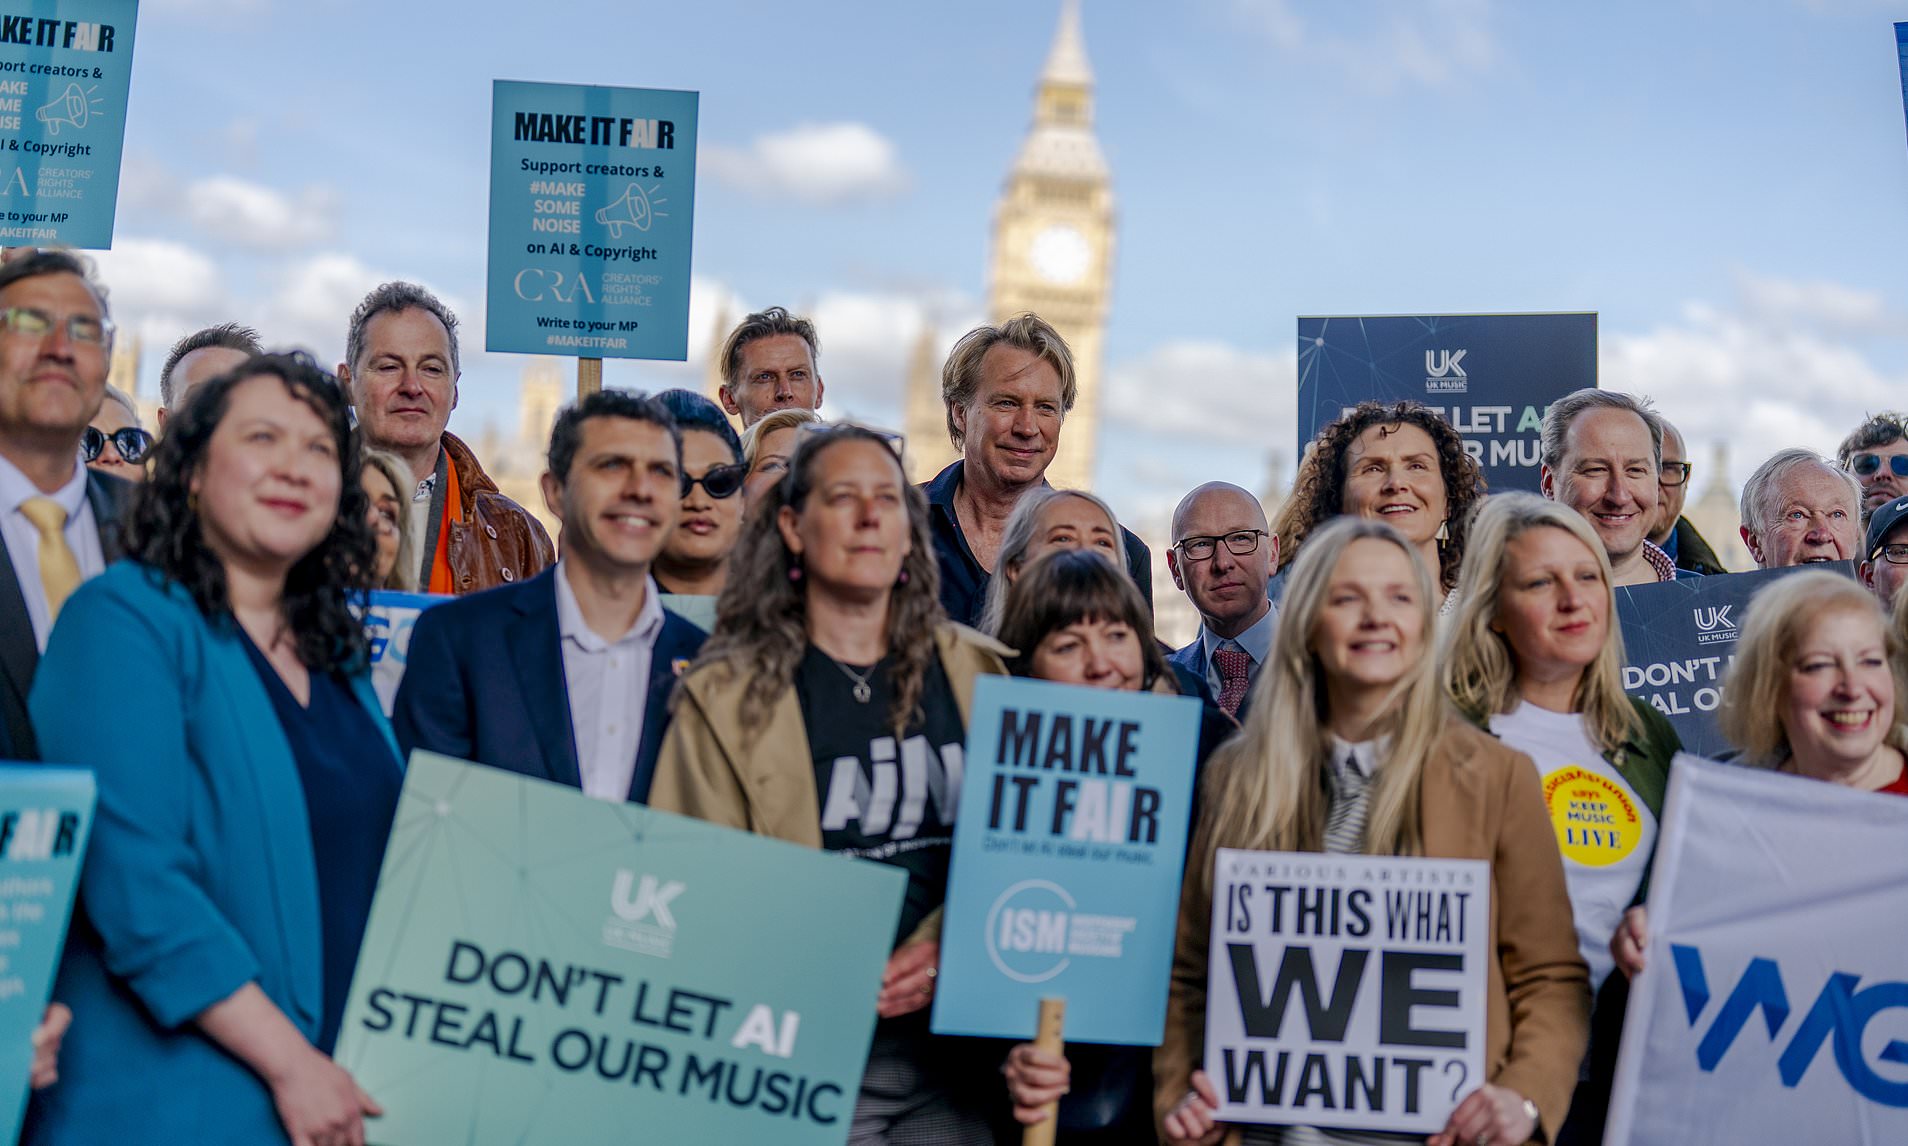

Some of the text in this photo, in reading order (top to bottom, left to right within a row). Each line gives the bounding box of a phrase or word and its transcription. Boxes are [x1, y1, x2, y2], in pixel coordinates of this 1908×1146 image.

[0, 14, 116, 52] KE IT FAIR
[30, 63, 89, 79] creators
[92, 67, 102, 79] &
[514, 111, 675, 149] MAKE IT FAIR
[9, 140, 19, 151] &
[23, 140, 91, 157] Copyright
[521, 158, 665, 178] Support creators &
[36, 188, 83, 199] ALLIANCE
[37, 178, 73, 188] RIGHTS
[530, 180, 586, 197] #MAKE
[8, 212, 19, 221] to
[22, 213, 48, 224] your
[50, 212, 69, 223] MP
[534, 199, 581, 215] SOME
[532, 218, 581, 234] NOISE
[527, 242, 657, 262] on AI & Copyright
[514, 268, 595, 304] CRA
[601, 284, 641, 294] RIGHTS
[601, 295, 653, 306] ALLIANCE
[537, 317, 638, 333] Write to your MP
[547, 335, 627, 349] #MAKEITFAIR
[1425, 349, 1467, 377] UK
[1452, 405, 1512, 433] LET
[1490, 439, 1546, 467] MU
[1693, 604, 1737, 631] UK
[1698, 631, 1738, 643] UK MUSIC
[1622, 656, 1720, 690] DON'T
[1646, 691, 1690, 715] AL
[996, 709, 1142, 777] MAKE
[989, 774, 1162, 844] IT FAIR
[1568, 811, 1616, 825] MUSIC
[1570, 801, 1608, 812] KEEP
[1567, 828, 1622, 849] LIVE
[1230, 861, 1475, 885] VARIOUS ARTISTS
[610, 867, 688, 929] UK
[1226, 883, 1470, 944] IS THIS WHAT
[1000, 908, 1067, 955] ISM
[445, 939, 800, 1059] DON'T LET AI
[1225, 942, 1468, 1049] WE
[362, 987, 845, 1126] STEAL OUR MUSIC
[1222, 1048, 1468, 1114] WANT?
